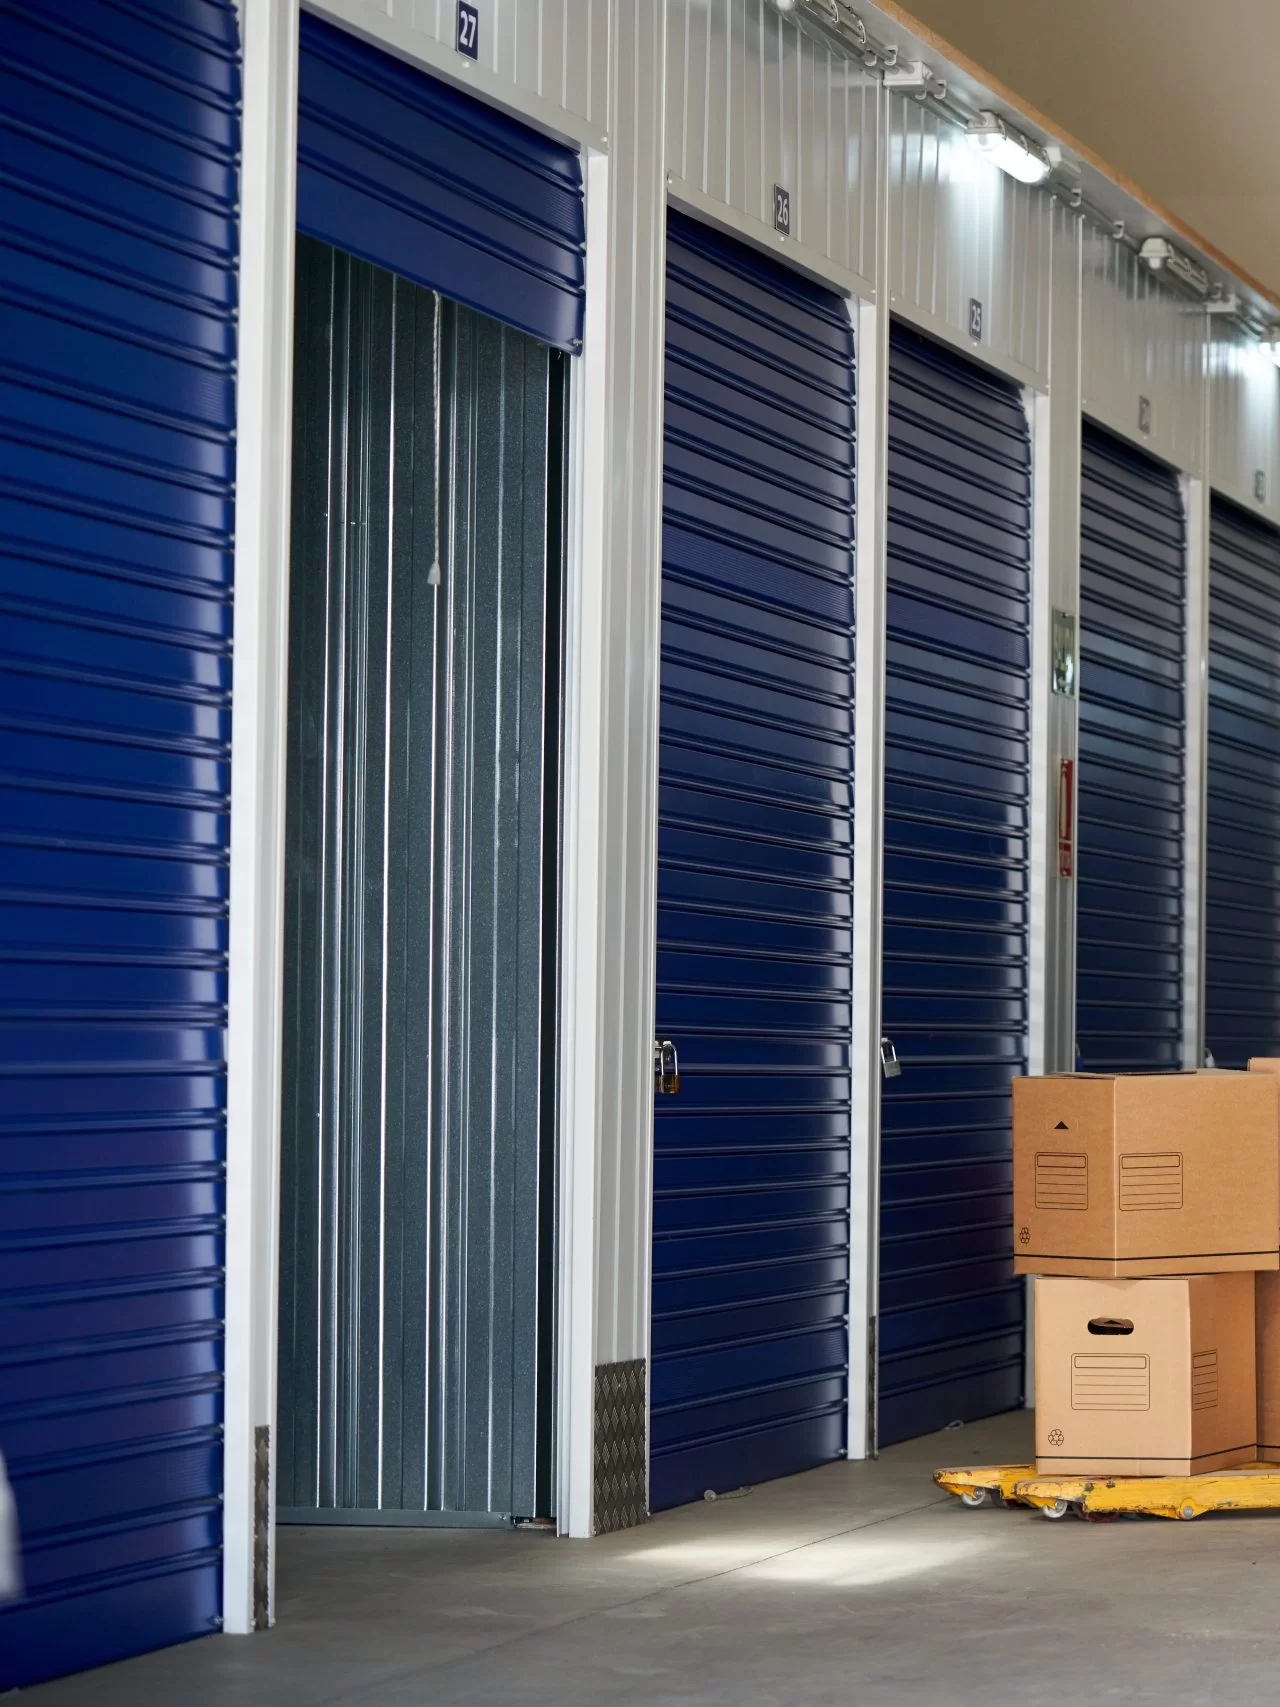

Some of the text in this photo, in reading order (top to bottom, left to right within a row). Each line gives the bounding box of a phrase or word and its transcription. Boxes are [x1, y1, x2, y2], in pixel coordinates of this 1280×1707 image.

[460, 10, 477, 48] 27
[777, 194, 788, 226] 26
[972, 305, 981, 332] 25
